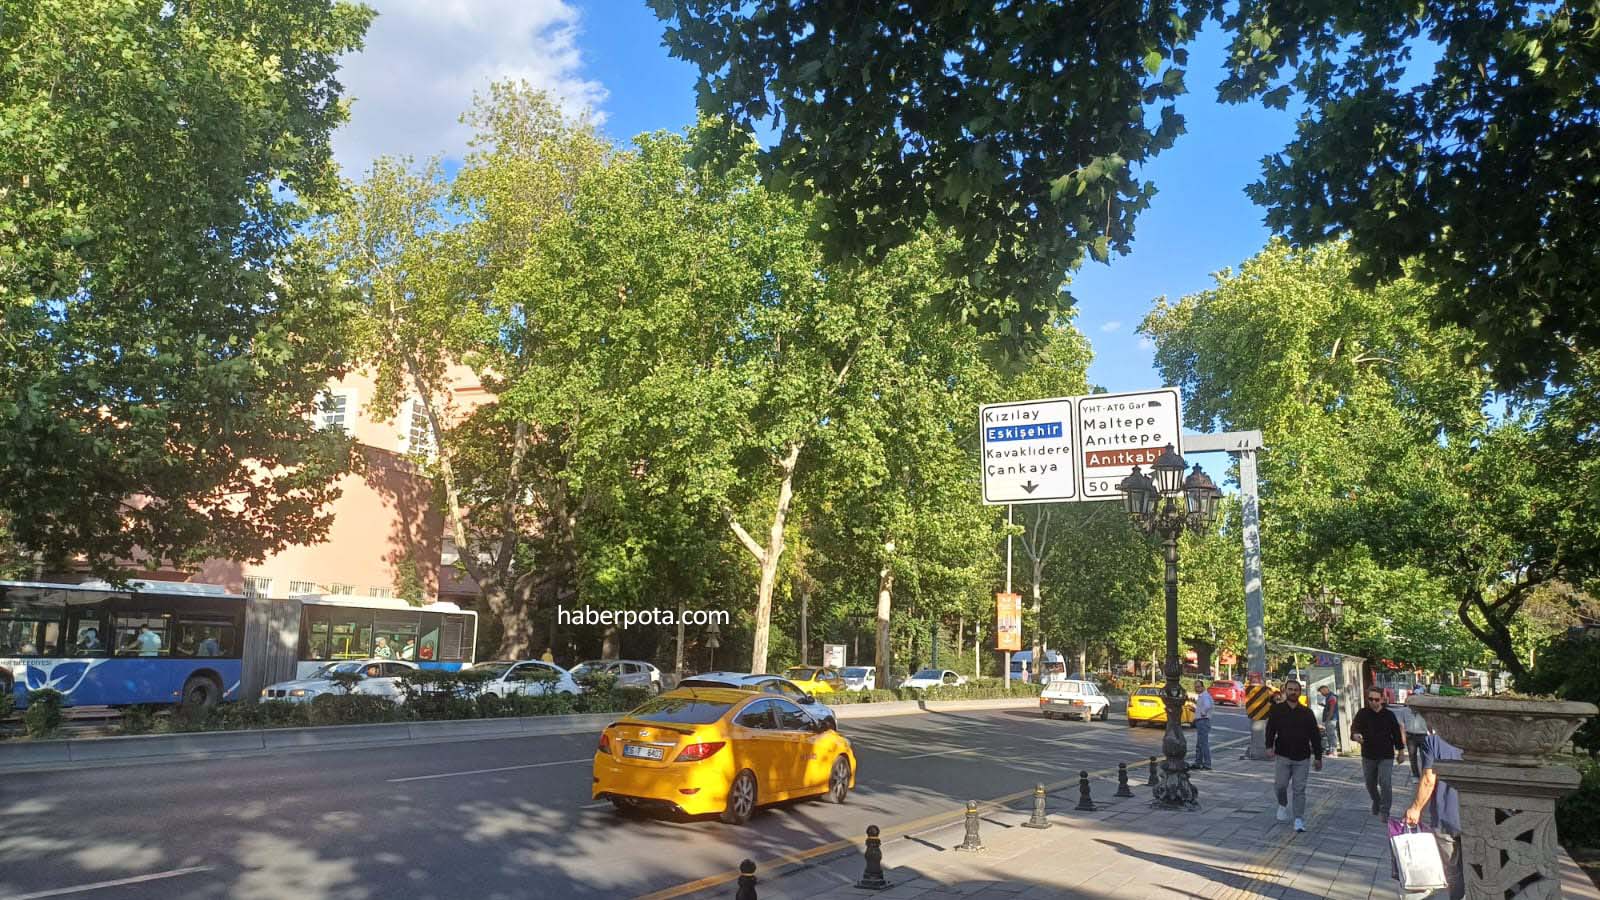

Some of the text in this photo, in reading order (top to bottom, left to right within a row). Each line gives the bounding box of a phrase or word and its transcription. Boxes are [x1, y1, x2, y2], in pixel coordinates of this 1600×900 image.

[1128, 402, 1146, 410] Gar
[985, 410, 1040, 422] Kızılay
[1084, 417, 1155, 430] Maltepe
[988, 424, 1059, 440] Eskişehir
[1086, 433, 1161, 446] Anıttepe
[986, 445, 1070, 459] Kavaklıdere
[1089, 449, 1162, 466] Anıtkabi
[987, 463, 1058, 477] Çankaya
[1089, 481, 1108, 492] 50
